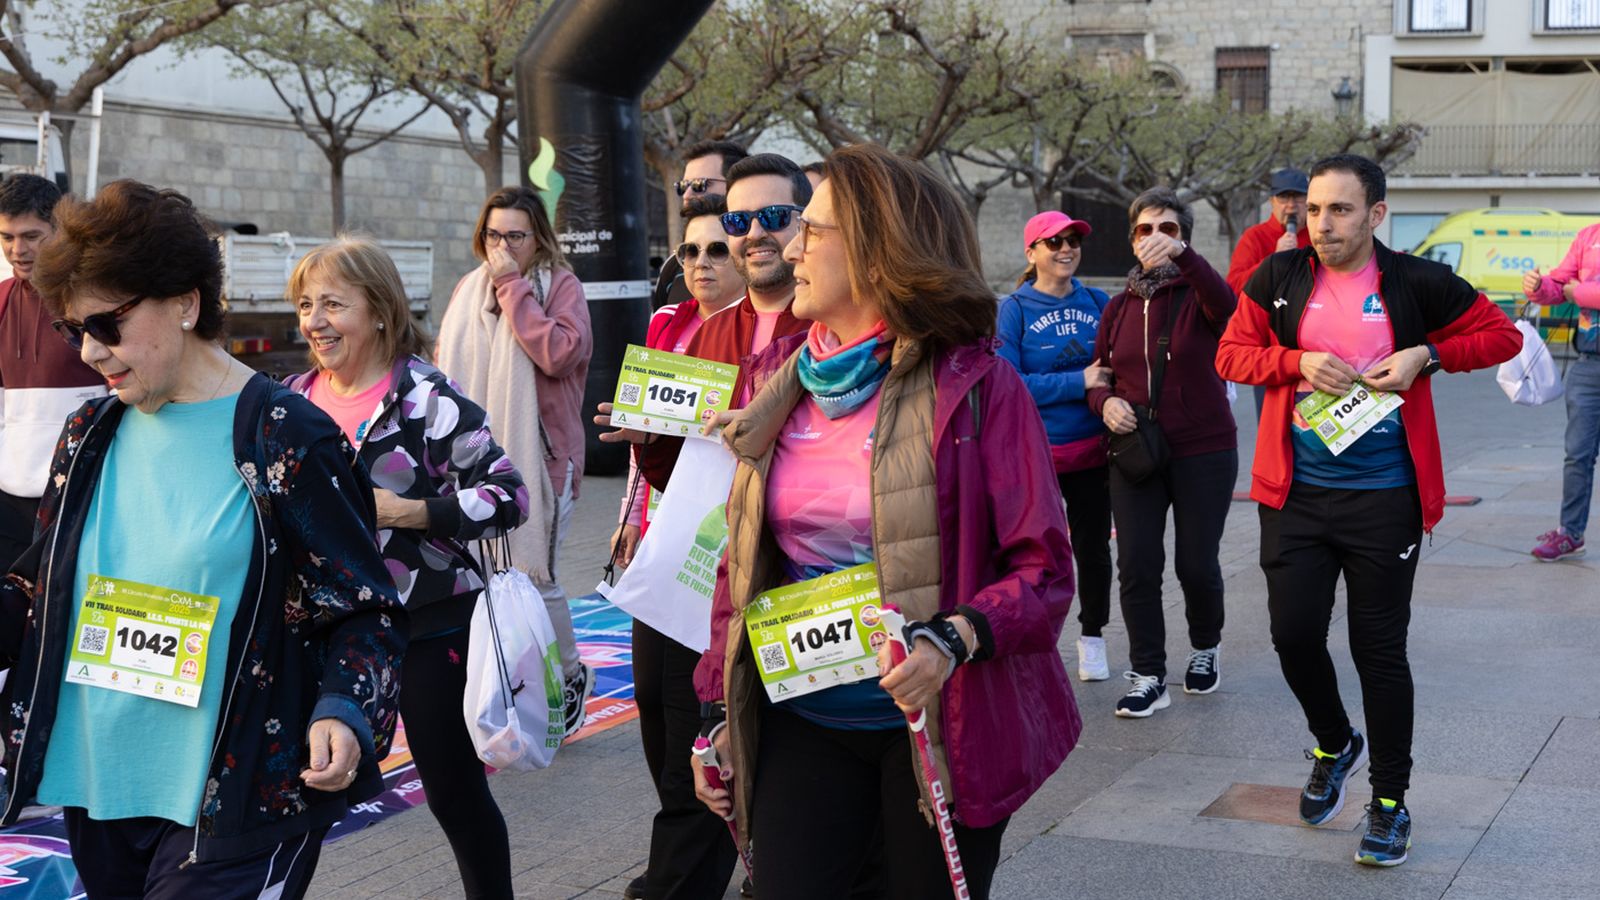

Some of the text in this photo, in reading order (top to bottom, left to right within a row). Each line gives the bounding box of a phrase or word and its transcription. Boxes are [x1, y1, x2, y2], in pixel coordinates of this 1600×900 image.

[557, 229, 613, 242] nicipal de
[573, 242, 600, 254] Jaén
[1029, 309, 1099, 333] THREE STRIPE
[1056, 322, 1078, 336] LIFE
[633, 366, 647, 374] TRAIL
[648, 369, 675, 379] SOLIDARIO
[648, 385, 697, 407] 1051
[1333, 389, 1369, 419] 1049
[688, 545, 716, 570] RUTA
[683, 559, 716, 585] CxM TRA
[830, 573, 851, 587] CxM
[676, 571, 714, 599] IES FUENT
[96, 602, 114, 612] TRAIL
[115, 606, 147, 618] SOLIDARIO
[750, 622, 760, 631] VII
[760, 616, 779, 628] TRAIL
[781, 608, 813, 622] SOLIDARIO
[117, 627, 178, 657] 1042
[791, 618, 853, 653] 1047
[548, 710, 564, 723] RUT
[545, 738, 559, 749] IES
